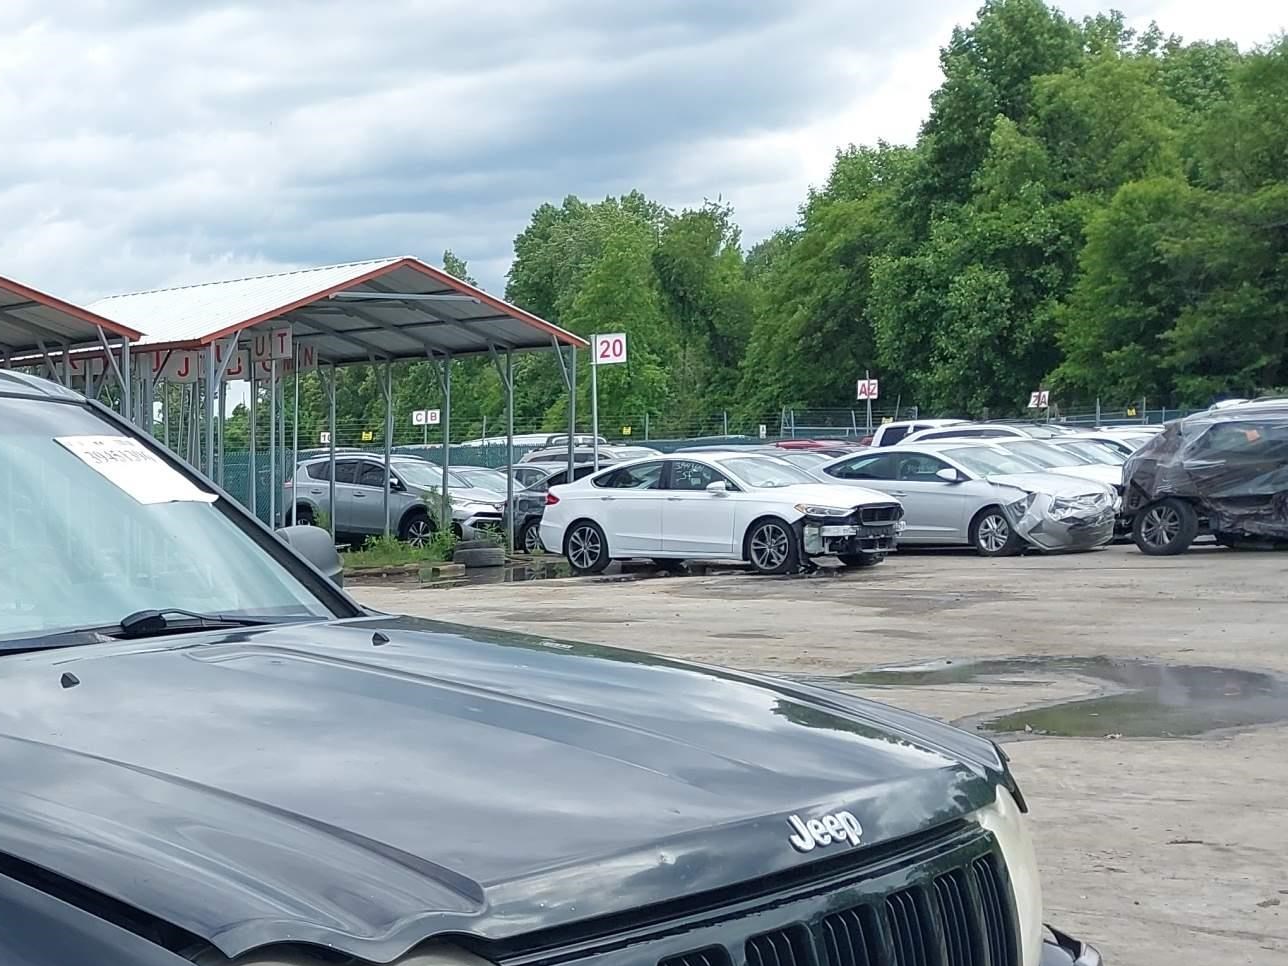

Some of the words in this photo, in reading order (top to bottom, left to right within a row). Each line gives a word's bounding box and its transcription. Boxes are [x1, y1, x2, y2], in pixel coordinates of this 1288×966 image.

[277, 332, 287, 354] T
[599, 338, 623, 359] 20
[177, 356, 189, 378] J
[786, 810, 863, 853] Jeep
